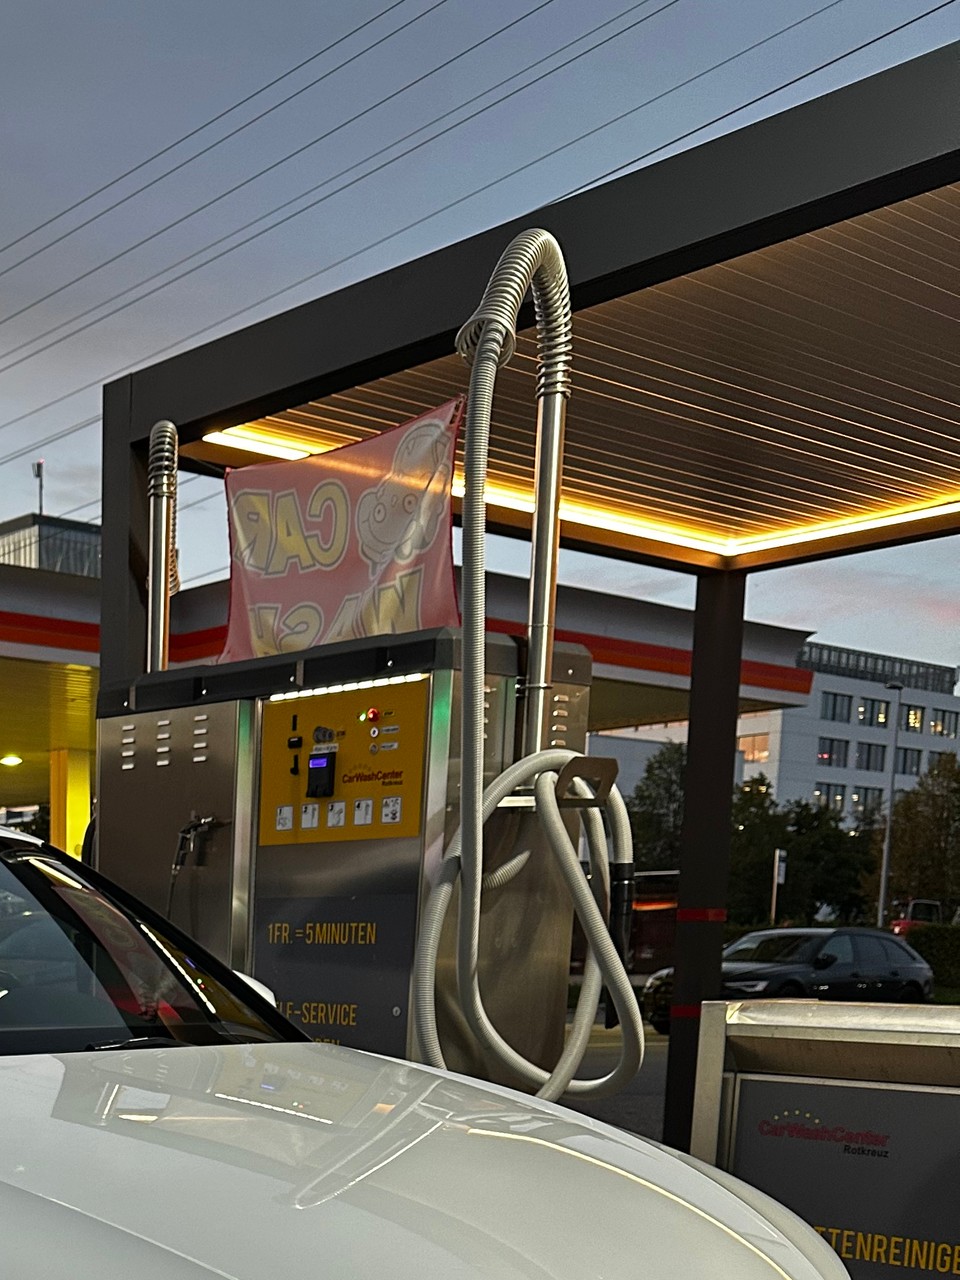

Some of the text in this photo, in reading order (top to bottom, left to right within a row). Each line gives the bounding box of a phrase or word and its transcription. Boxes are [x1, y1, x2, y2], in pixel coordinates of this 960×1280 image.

[342, 770, 403, 784] CarWashCenter
[315, 922, 377, 945] MINUTEN
[843, 1145, 890, 1158] Rotkreuz
